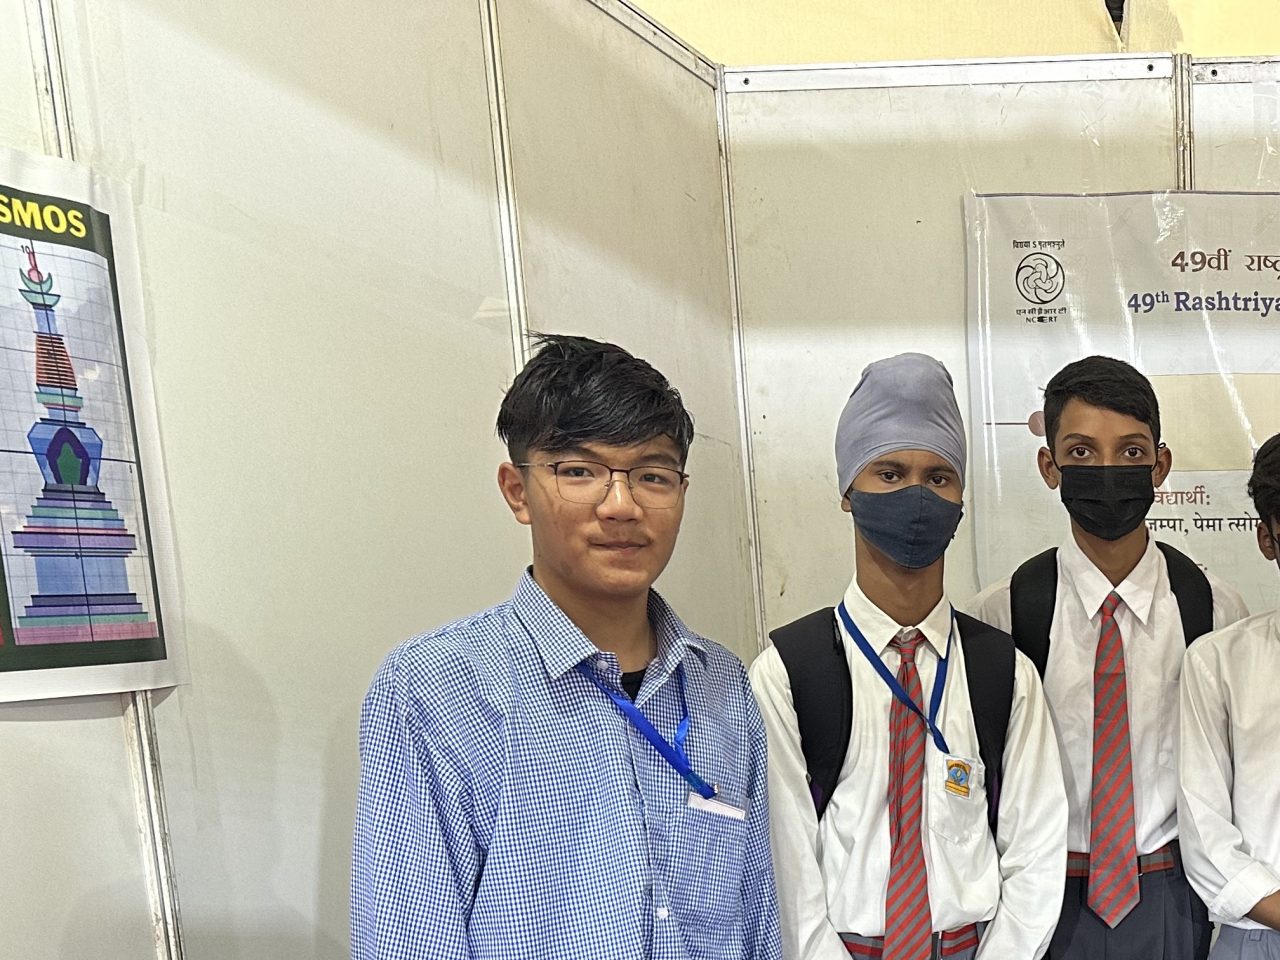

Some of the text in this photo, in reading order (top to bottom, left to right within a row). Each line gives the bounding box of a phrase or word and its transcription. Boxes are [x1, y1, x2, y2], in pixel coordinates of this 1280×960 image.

[1171, 248, 1232, 272] 49वीं
[1127, 290, 1170, 314] 49th
[1193, 512, 1223, 532] पेमा
